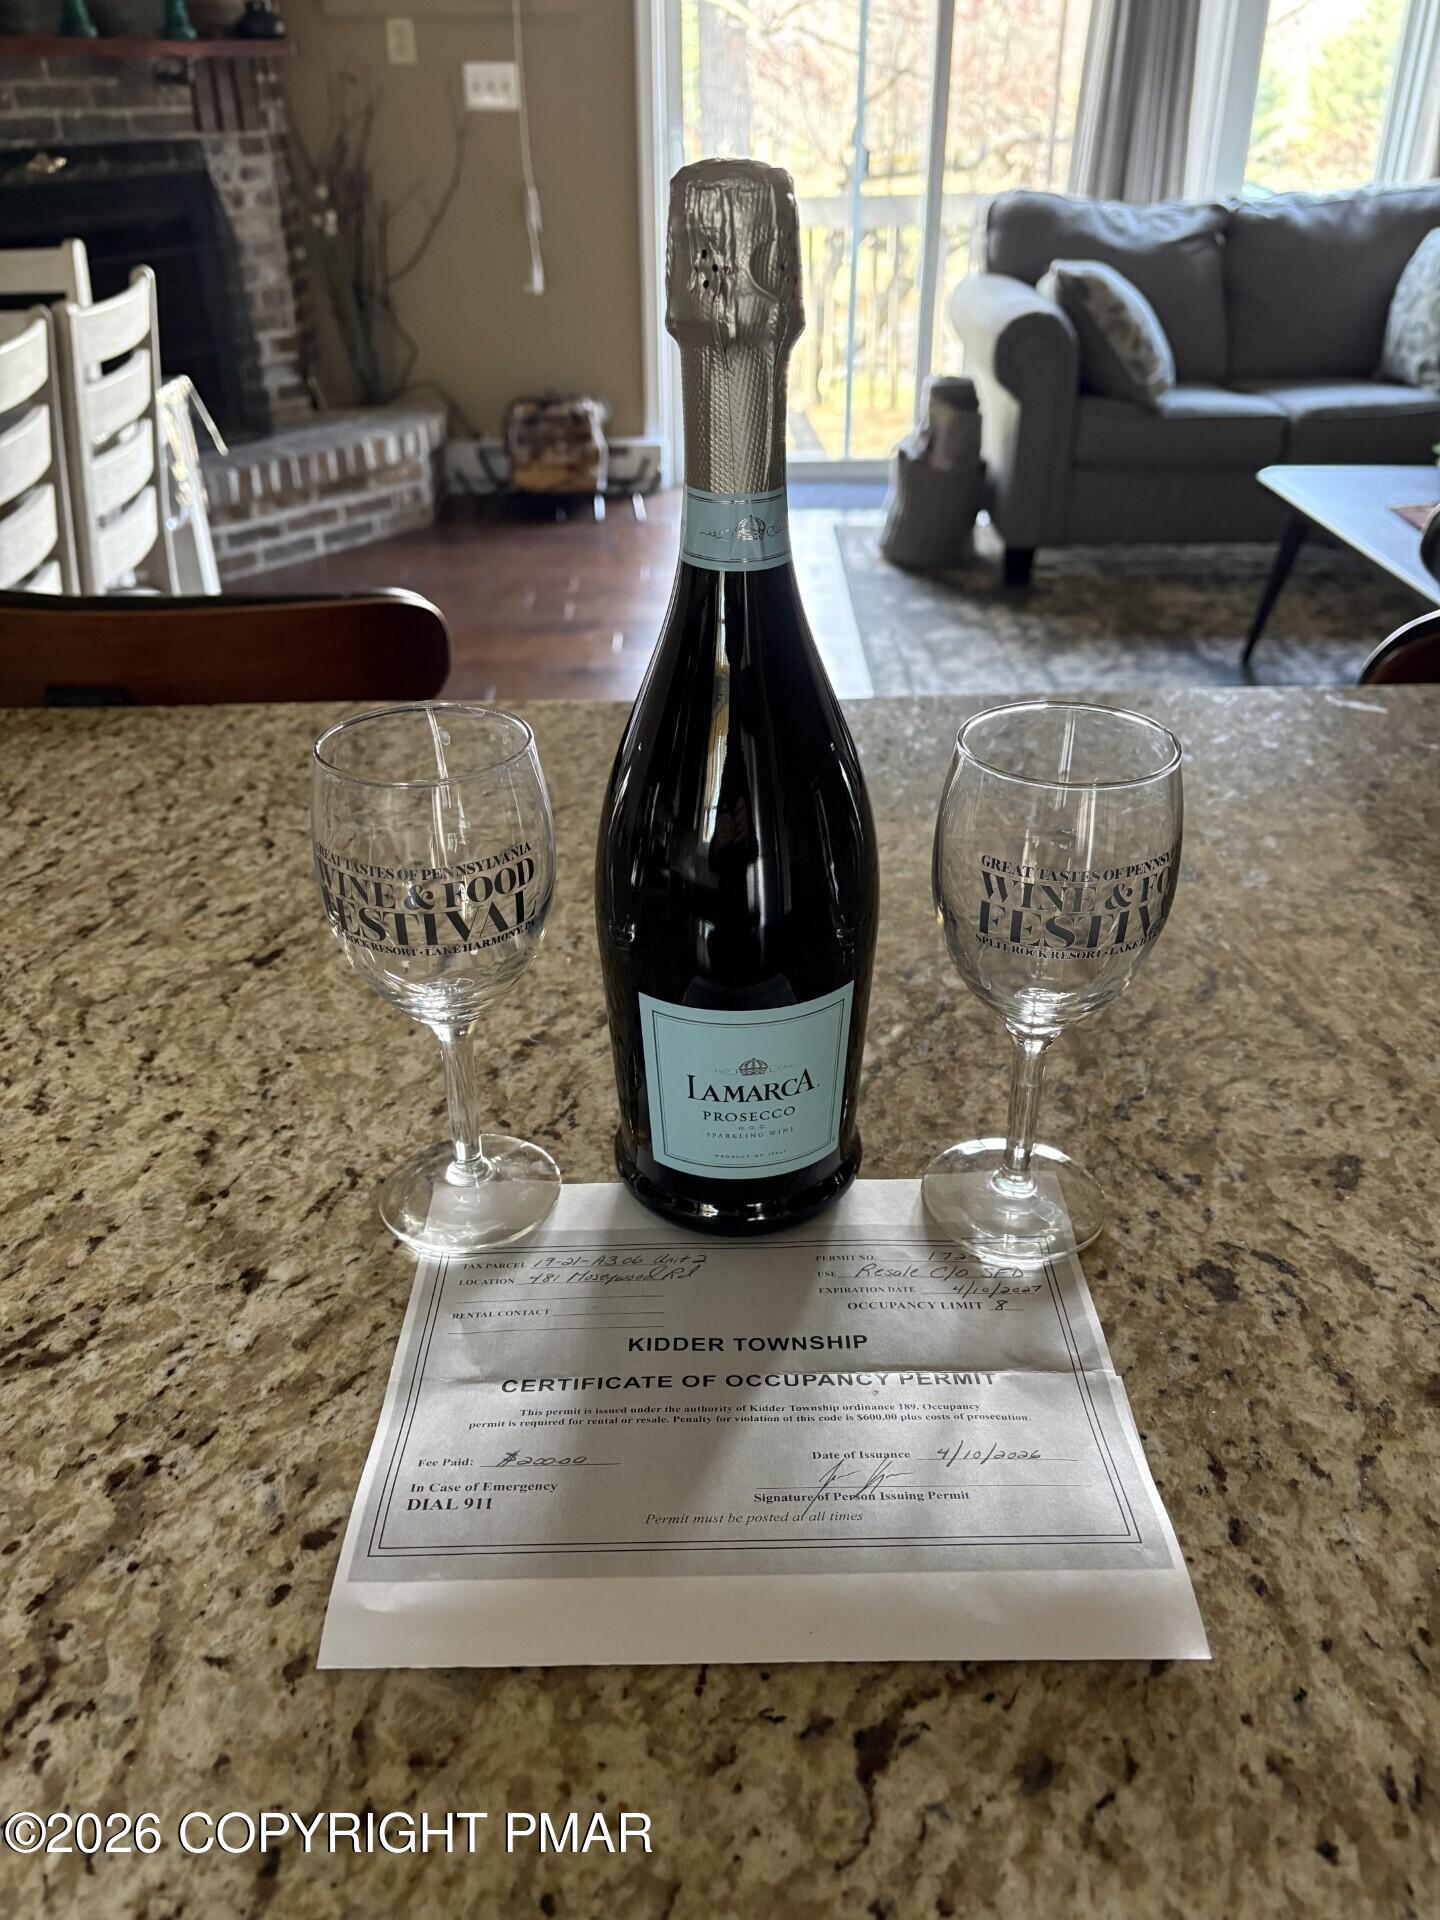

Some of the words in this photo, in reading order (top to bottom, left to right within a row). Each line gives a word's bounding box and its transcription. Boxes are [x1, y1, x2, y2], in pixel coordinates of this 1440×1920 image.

[345, 859, 395, 880] TASTES
[397, 869, 419, 881] OF
[422, 841, 532, 880] PENNSYLVANIA
[981, 854, 1035, 878] GREAT
[1036, 867, 1101, 882] TASTES
[1103, 868, 1124, 880] OF
[404, 884, 436, 911] &
[440, 858, 535, 908] FOOD
[981, 870, 1097, 913] WINE
[1105, 883, 1133, 910] &
[1011, 945, 1048, 959] ROCK
[1050, 950, 1104, 960] RESORT
[702, 1106, 796, 1122] PROSECCO
[706, 1131, 764, 1139] SPARKLING
[855, 1262, 920, 1278] Resale
[459, 1277, 515, 1287] LOCATION
[529, 1272, 561, 1284] 481
[819, 1286, 885, 1294] EXPIRATION
[952, 1279, 1042, 1299] 4/10/2027
[847, 1301, 937, 1311] OCCUPANCY
[941, 1301, 984, 1310] LIMIT
[994, 1299, 1009, 1311] 8
[451, 1311, 496, 1320] RENTAL
[497, 1308, 551, 1318] CONTACT
[628, 1337, 724, 1352] KIDDER
[732, 1335, 868, 1352] TOWNSHIP
[501, 1375, 673, 1393] CERTIFICATE
[681, 1374, 717, 1388] OF
[725, 1373, 890, 1388] OCCUPANCY
[899, 1373, 996, 1386] PERMIT
[520, 1408, 544, 1417] This
[545, 1407, 581, 1419] permit
[584, 1407, 592, 1415] is
[595, 1406, 627, 1415] issued
[630, 1406, 662, 1414] under
[664, 1405, 681, 1413] the
[684, 1404, 732, 1414] authority
[735, 1404, 747, 1412] of
[750, 1404, 786, 1412] Kidder
[789, 1403, 839, 1414] Township
[842, 1403, 895, 1411] ordinance
[899, 1403, 920, 1411] 189.
[922, 1403, 982, 1413] Occupancy
[468, 1420, 505, 1430] permit
[519, 1418, 565, 1428] required
[568, 1418, 585, 1426] for
[587, 1417, 618, 1426] rental
[636, 1416, 670, 1424] resale.
[673, 1415, 712, 1425] Penalty
[716, 1415, 731, 1423] for
[734, 1414, 780, 1423] violation
[783, 1414, 794, 1422] of
[797, 1413, 816, 1422] this
[818, 1413, 843, 1422] code
[845, 1413, 854, 1421] is
[856, 1413, 898, 1422] $600.00
[900, 1413, 923, 1423] plus
[925, 1413, 951, 1421] costs
[953, 1413, 964, 1421] of
[966, 1413, 1032, 1423] prosecution.
[812, 1450, 841, 1460] Date
[843, 1450, 856, 1459] of
[858, 1450, 912, 1460] Issuance
[936, 1440, 1042, 1468] 4/10/2026
[418, 1458, 440, 1468] Fee
[441, 1457, 475, 1467] Paid:
[410, 1483, 425, 1493] In
[429, 1482, 461, 1493] Case
[464, 1481, 480, 1492] of
[482, 1481, 559, 1494] Emergency
[407, 1498, 459, 1511] DIAL
[464, 1497, 493, 1510] 911
[753, 1492, 817, 1504] Signature
[817, 1492, 830, 1501] of
[833, 1491, 876, 1502] Person
[879, 1490, 925, 1502] Issuing
[927, 1490, 970, 1501] Permit
[645, 1513, 689, 1525] Permit
[692, 1513, 725, 1523] must
[728, 1512, 743, 1523] be
[745, 1511, 790, 1525] posted
[808, 1511, 826, 1521] all
[829, 1511, 864, 1521] times
